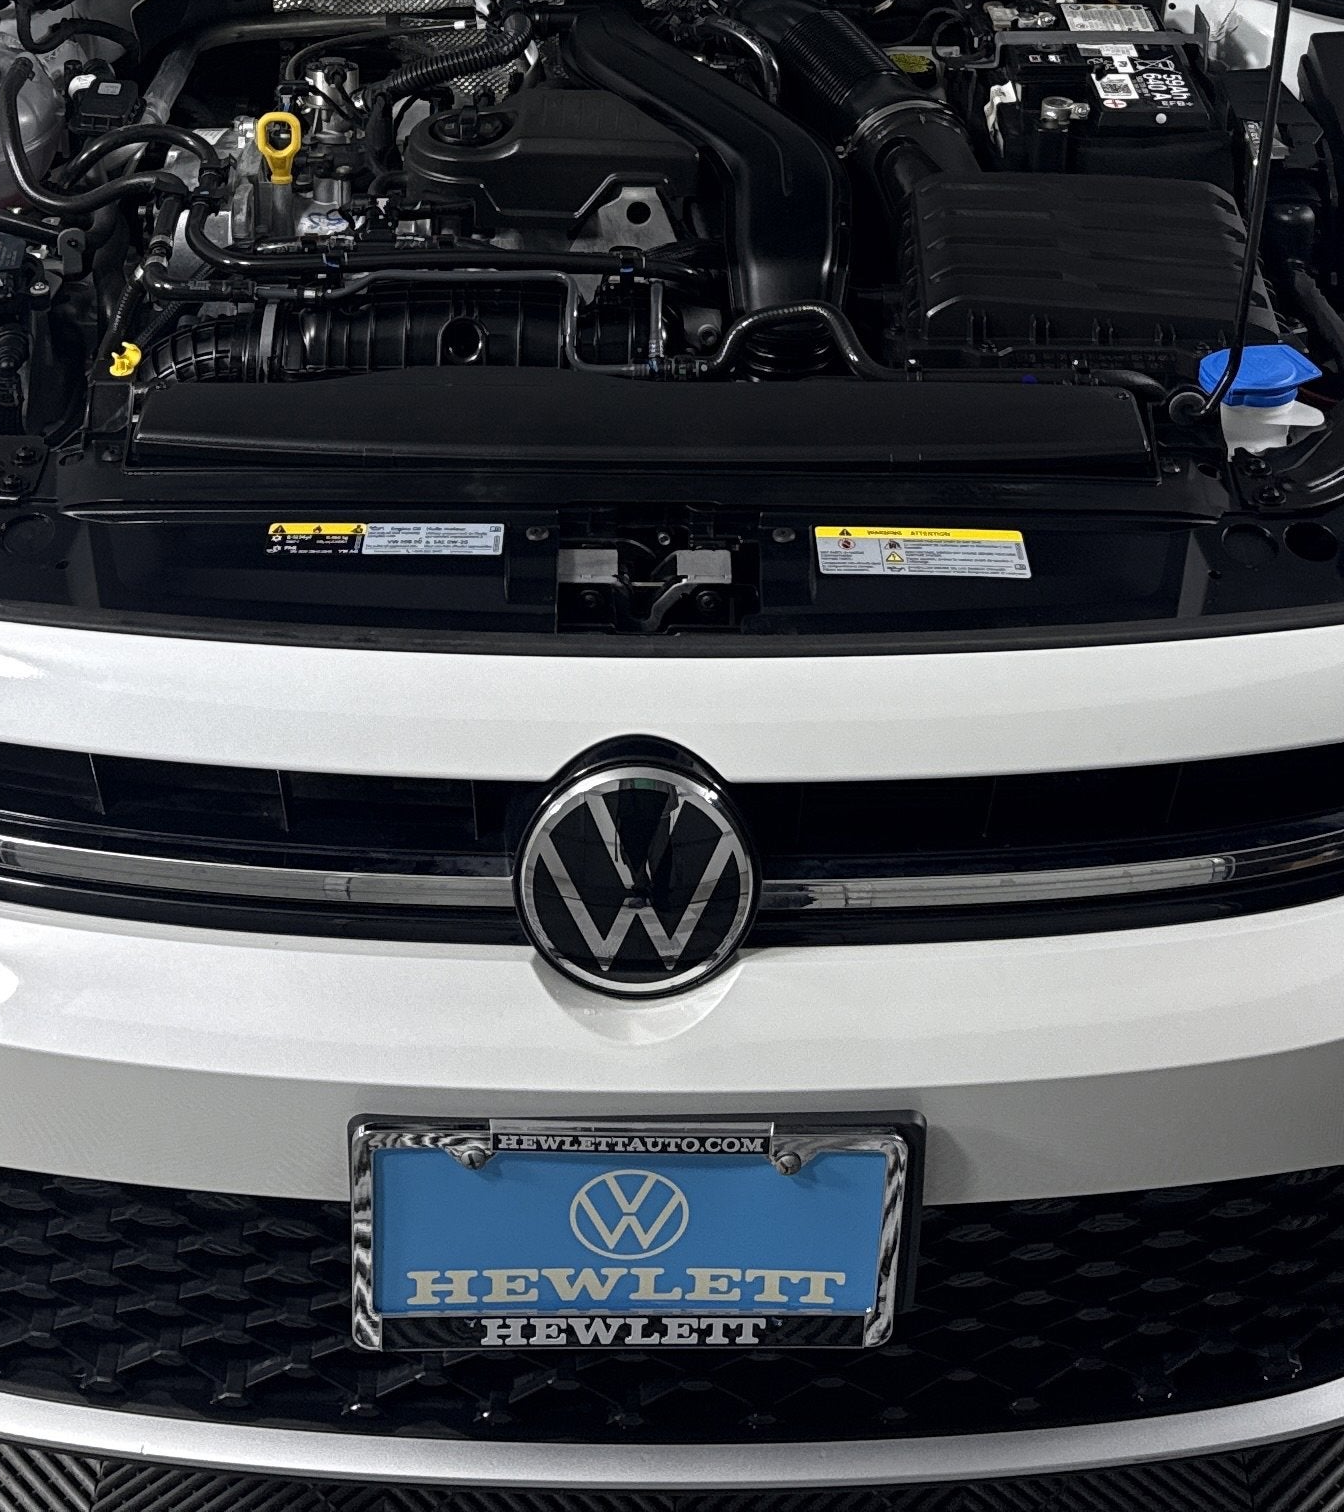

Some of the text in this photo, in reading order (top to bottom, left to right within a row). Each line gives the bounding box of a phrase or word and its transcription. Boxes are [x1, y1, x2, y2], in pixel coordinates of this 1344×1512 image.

[1163, 73, 1192, 100] 59Ah
[497, 1133, 766, 1154] HEWLETTAUTO.COM
[406, 1266, 846, 1306] HEWLETT
[479, 1316, 767, 1346] HEWLETT
